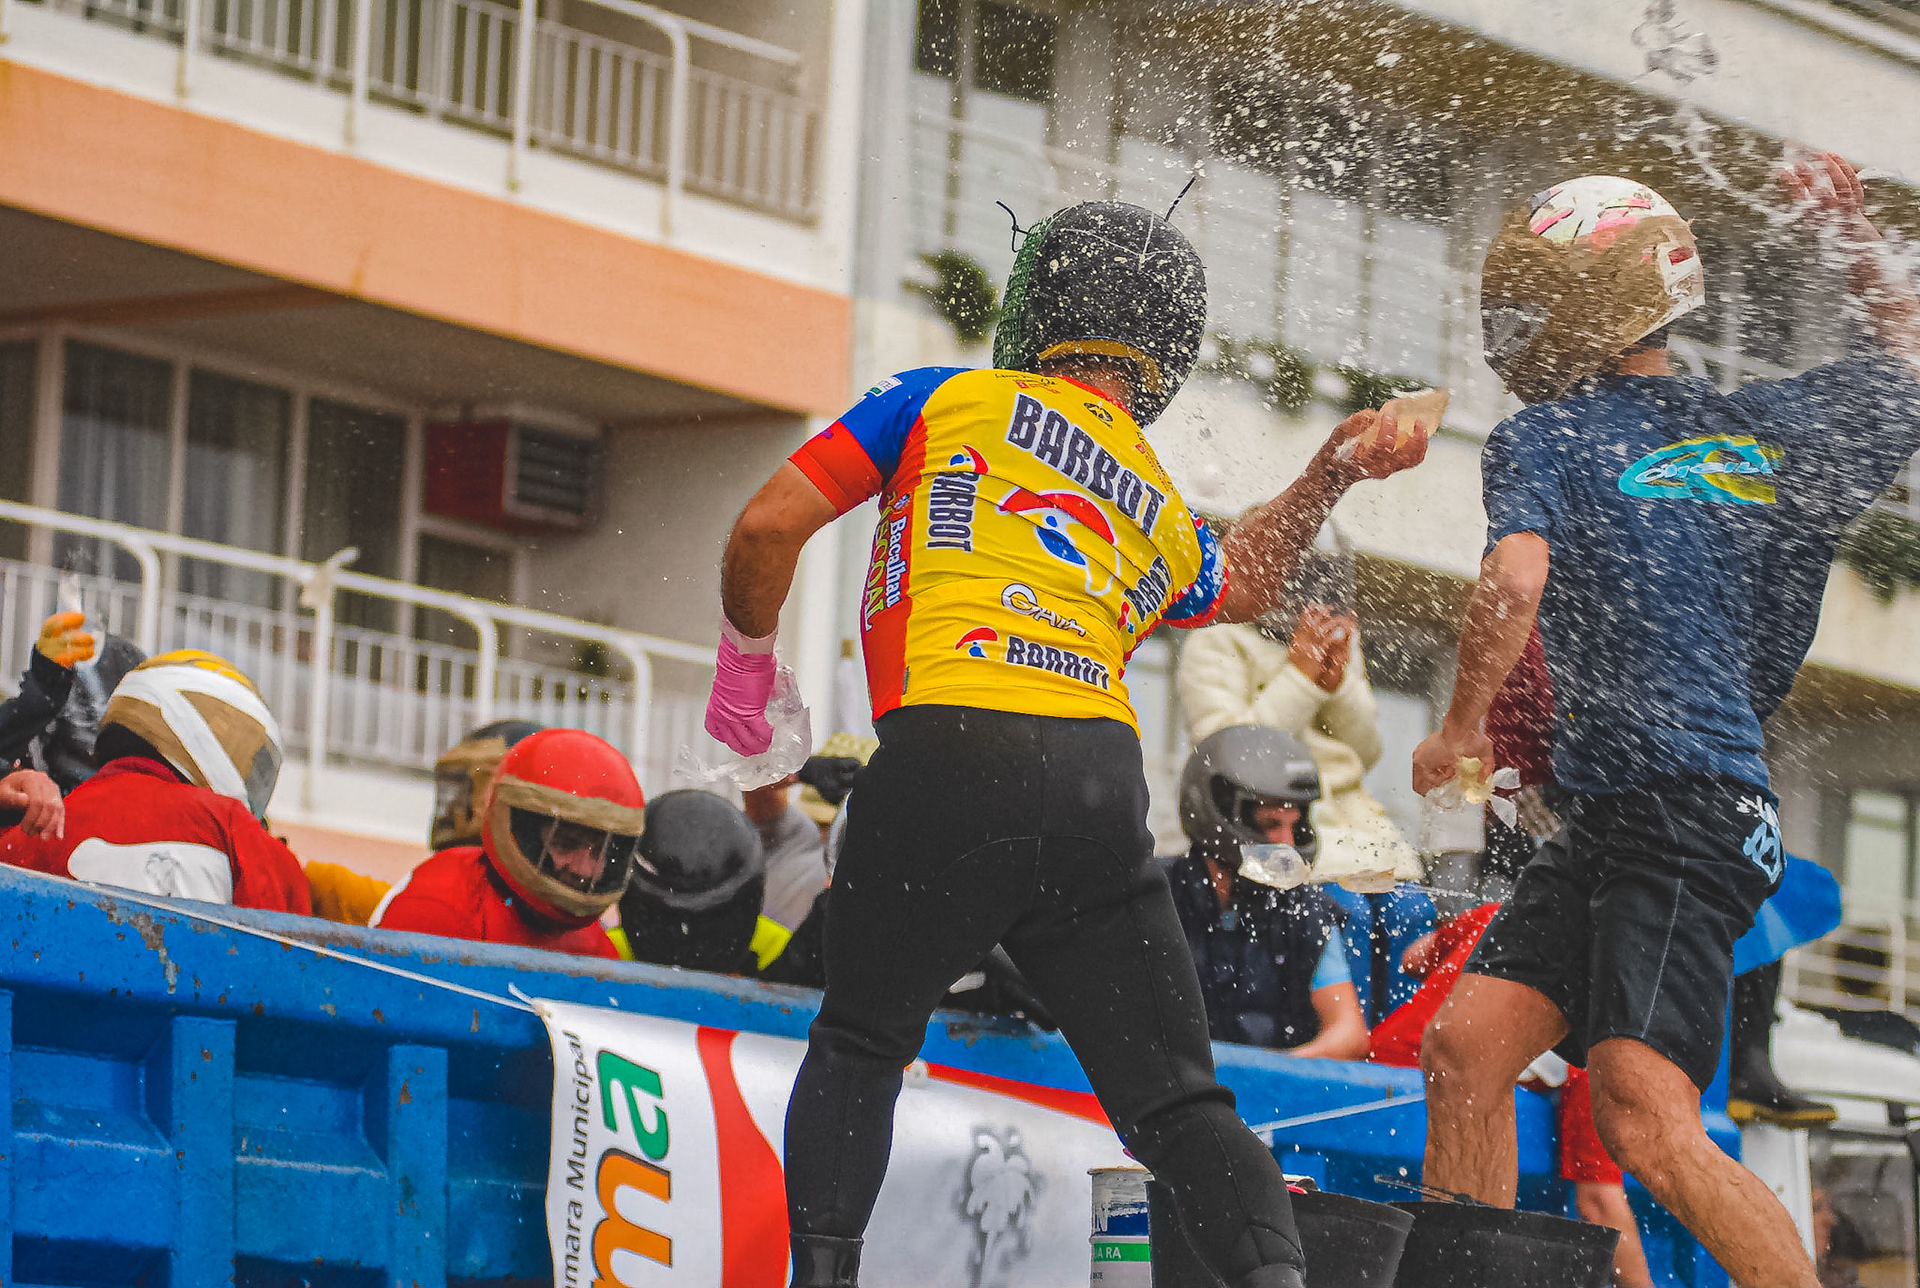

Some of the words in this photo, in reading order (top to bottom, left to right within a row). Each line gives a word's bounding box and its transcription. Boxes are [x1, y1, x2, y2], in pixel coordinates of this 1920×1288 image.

[1004, 391, 1167, 538] BARBOT
[886, 515, 908, 608] Bacalhau
[562, 1029, 596, 1192] Municipal
[563, 1199, 584, 1288] mara
